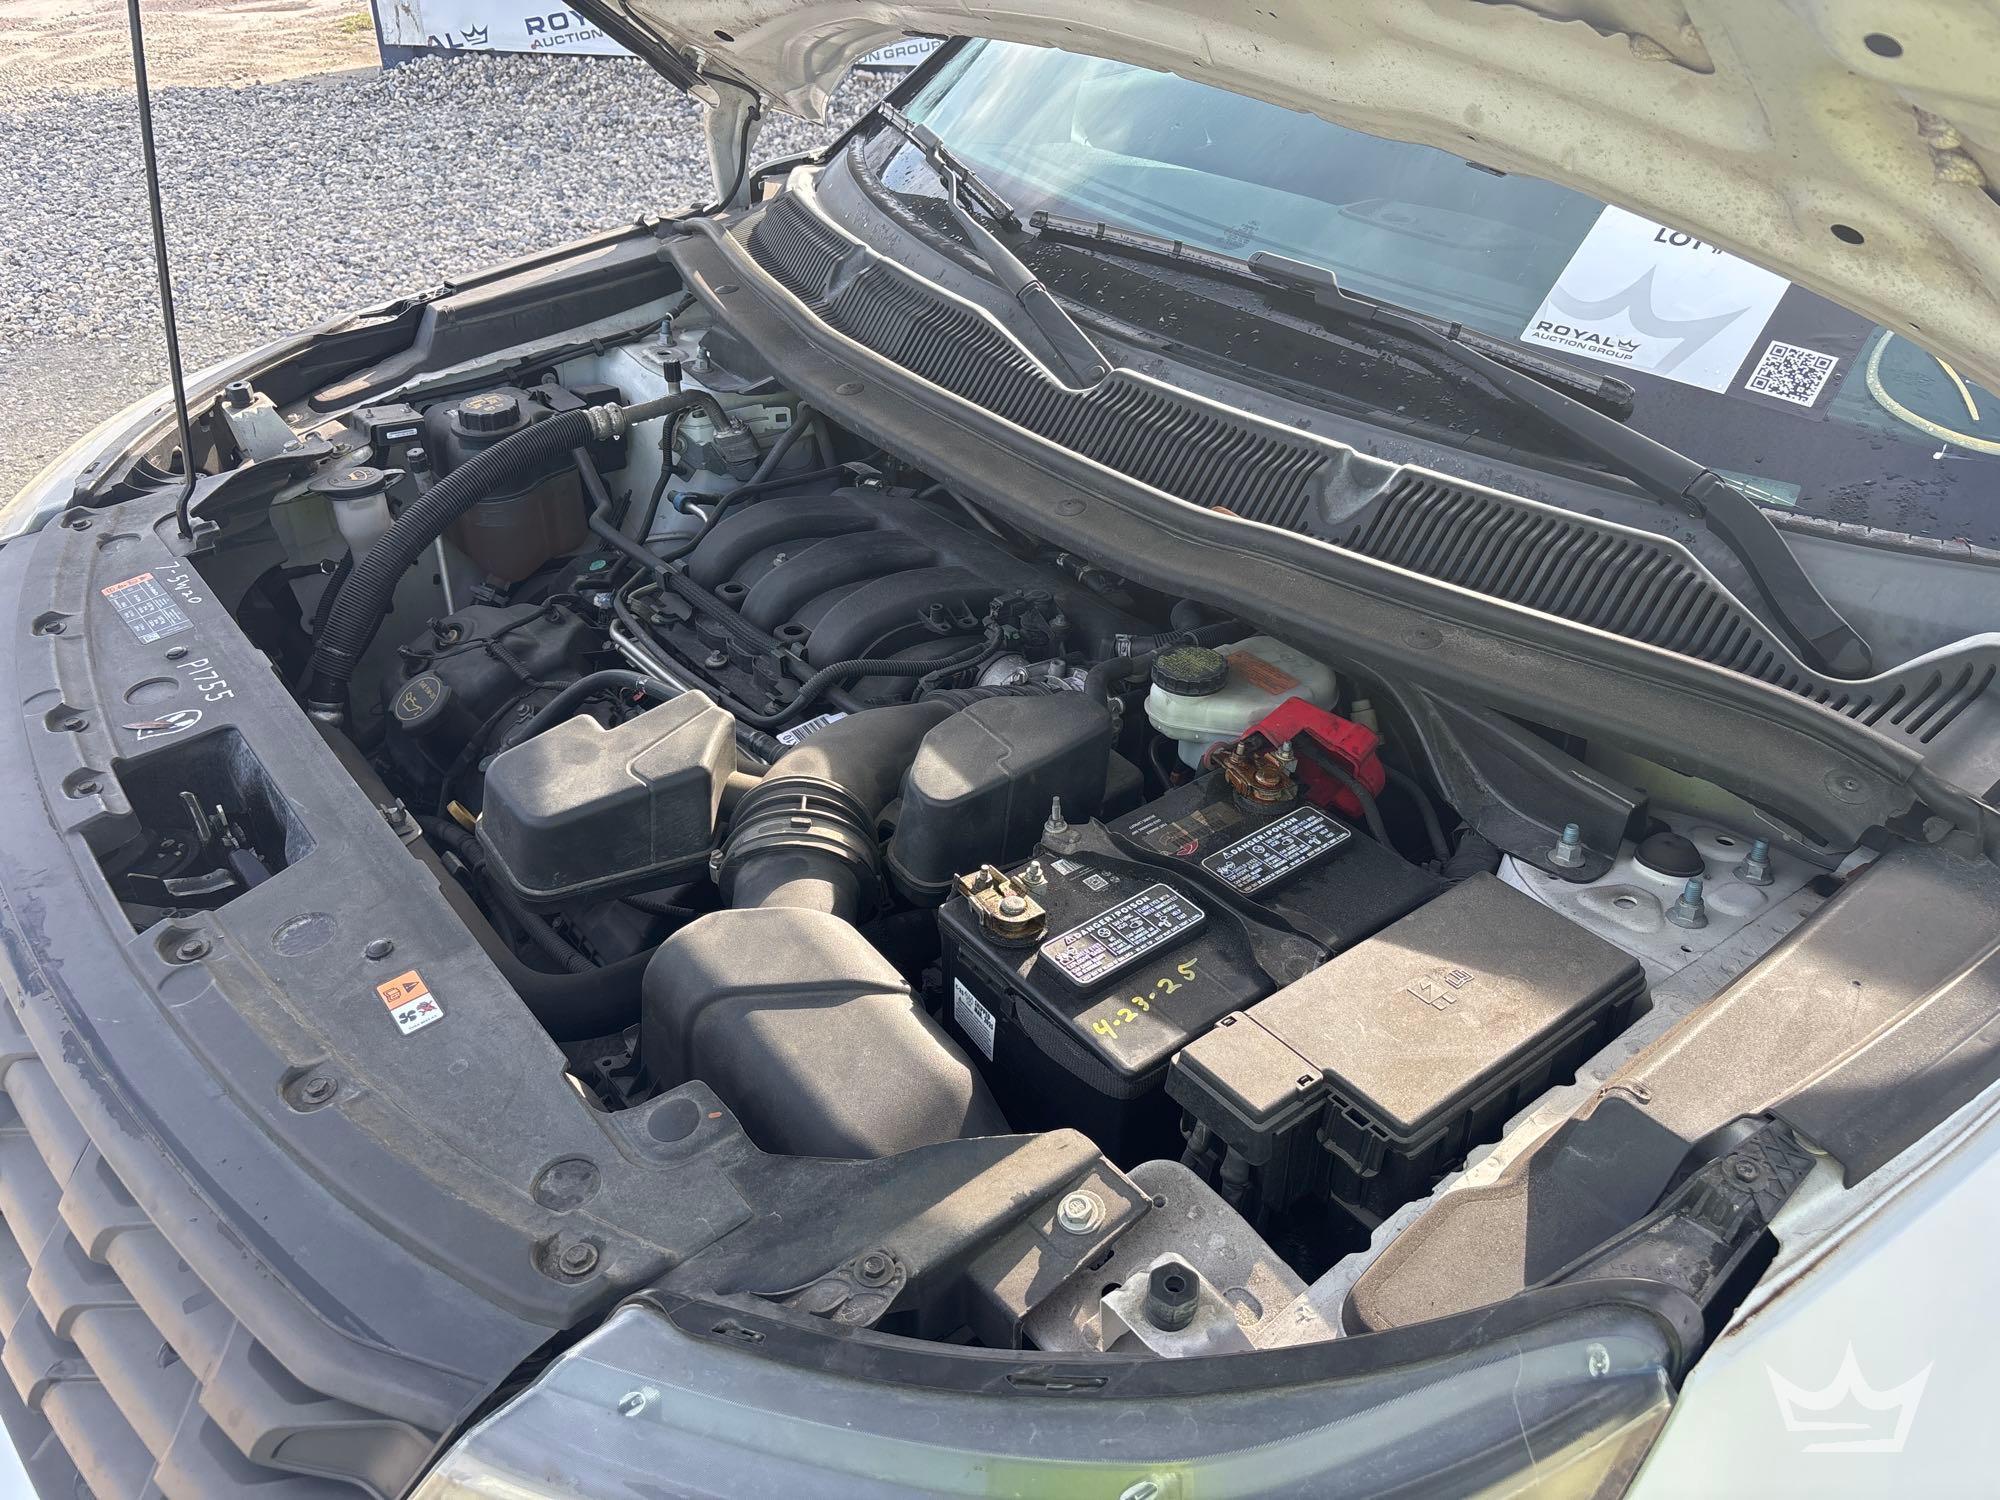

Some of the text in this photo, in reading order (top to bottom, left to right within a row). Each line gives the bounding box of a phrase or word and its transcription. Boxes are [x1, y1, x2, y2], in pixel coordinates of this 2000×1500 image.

[531, 29, 604, 50] AUCTION
[1532, 331, 1633, 361] AUCTION GROUP
[1536, 320, 1614, 348] ROYAL
[1230, 816, 1299, 857] DANGER/POISON
[1075, 895, 1151, 941] DANGER/POISON
